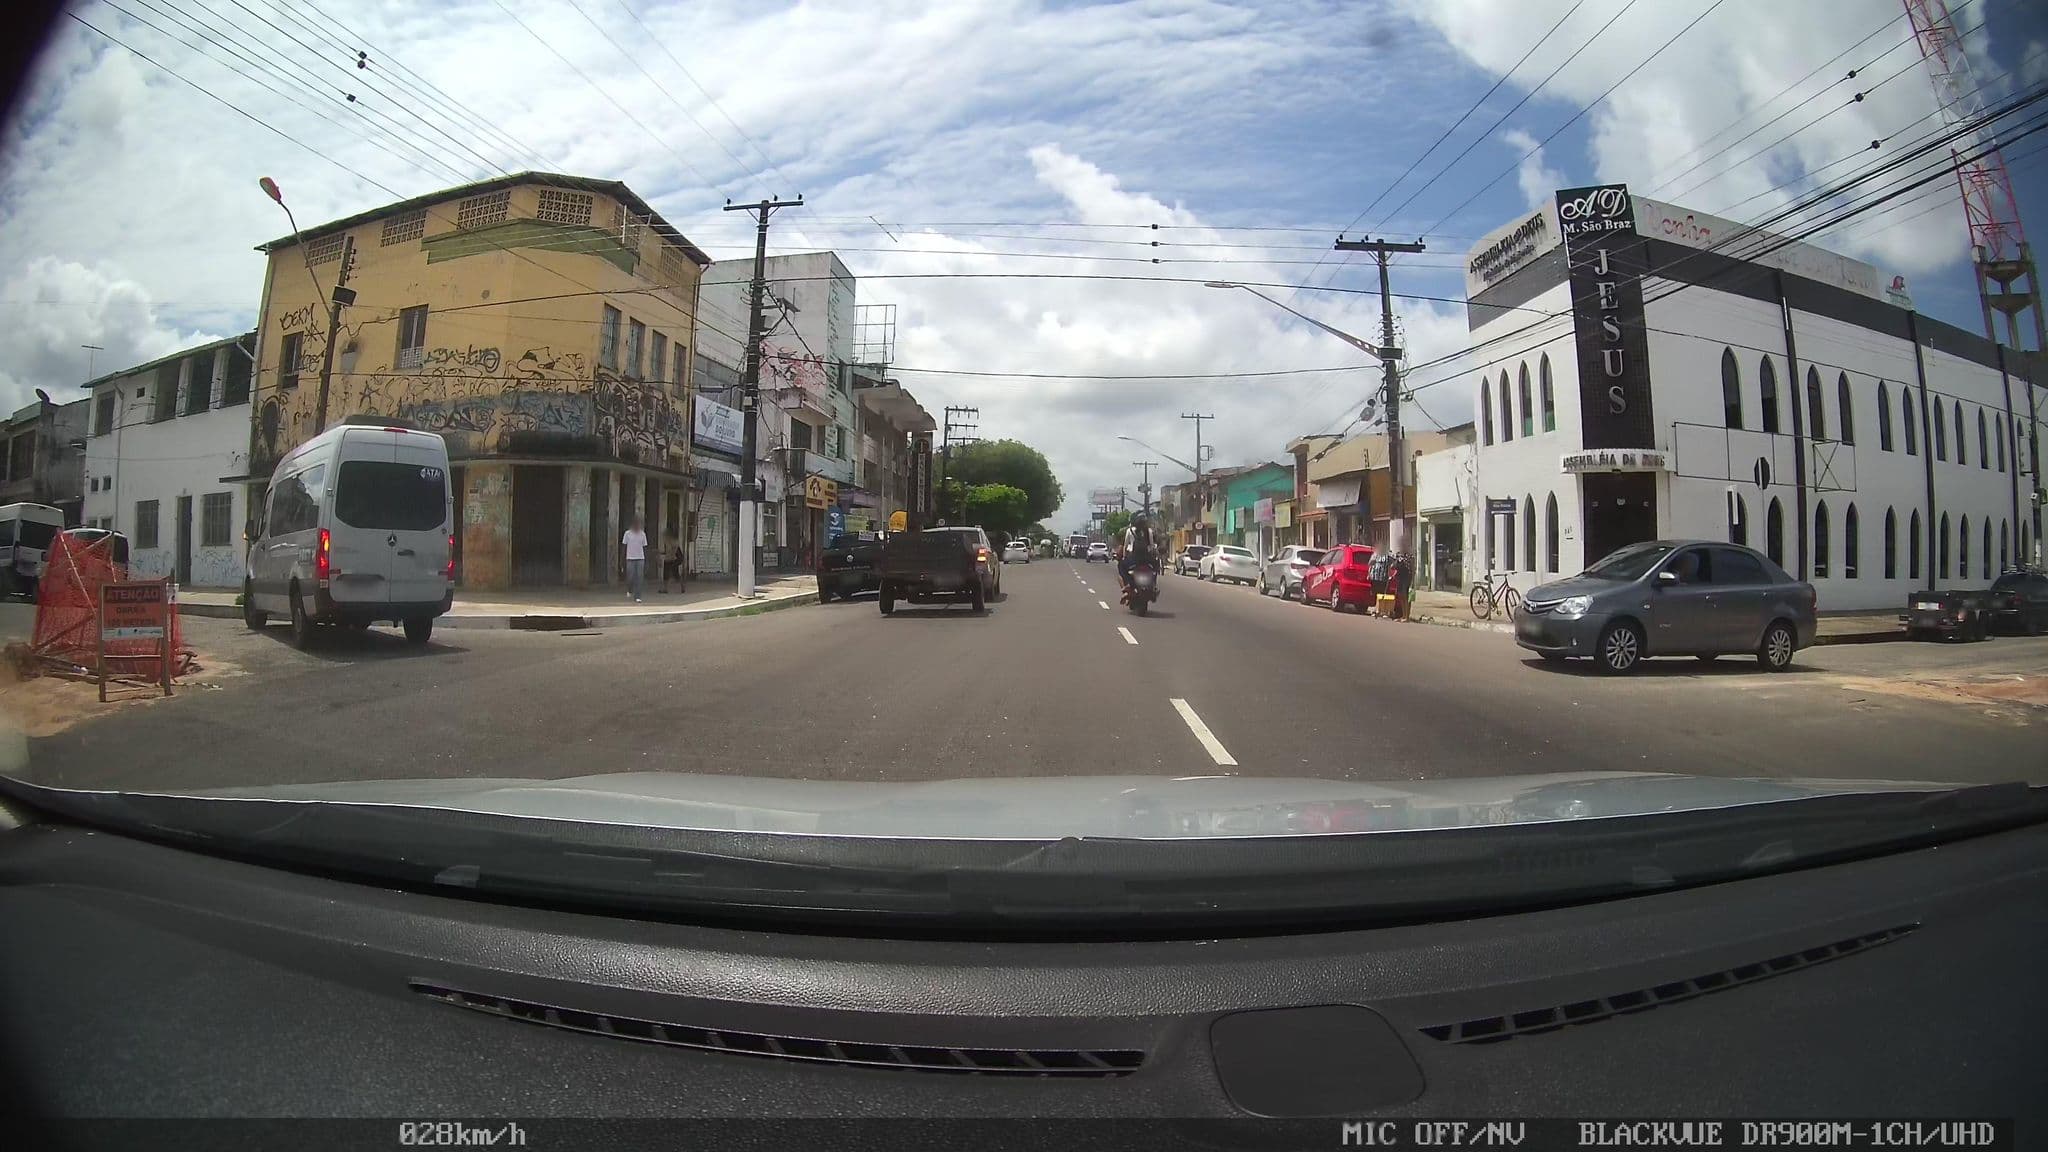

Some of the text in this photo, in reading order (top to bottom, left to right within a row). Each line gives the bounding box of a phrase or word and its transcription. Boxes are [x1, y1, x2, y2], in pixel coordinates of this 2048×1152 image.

[1581, 220, 1602, 232] São
[1605, 219, 1632, 230] Braz
[1594, 248, 1627, 415] JESUS
